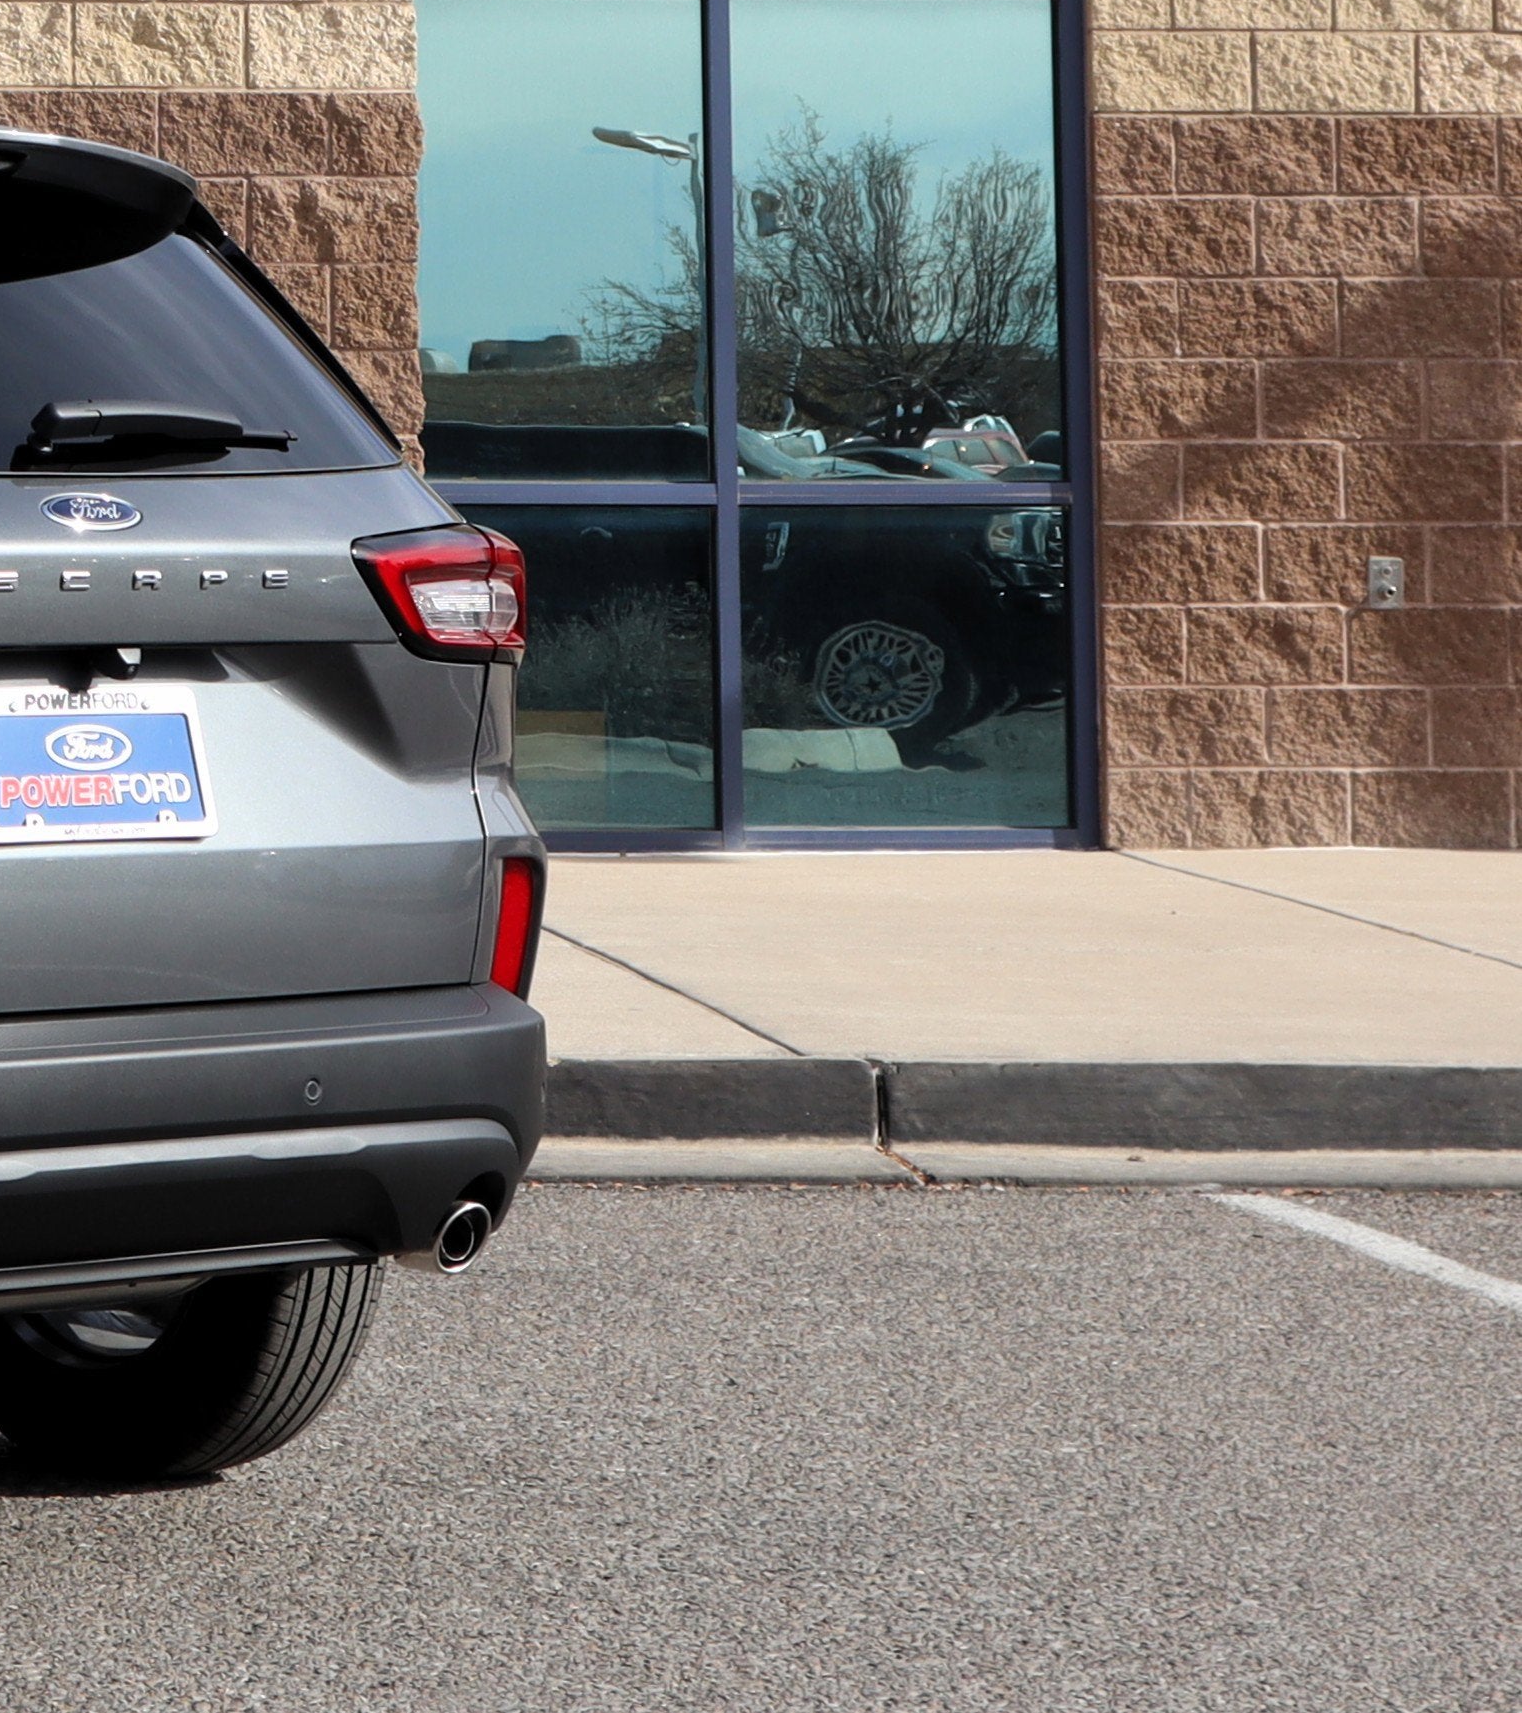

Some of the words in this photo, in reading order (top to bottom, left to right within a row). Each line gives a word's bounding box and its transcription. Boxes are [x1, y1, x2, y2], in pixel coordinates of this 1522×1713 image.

[69, 497, 122, 519] Ford
[24, 692, 138, 710] POWERFORD
[63, 733, 115, 761] Ford
